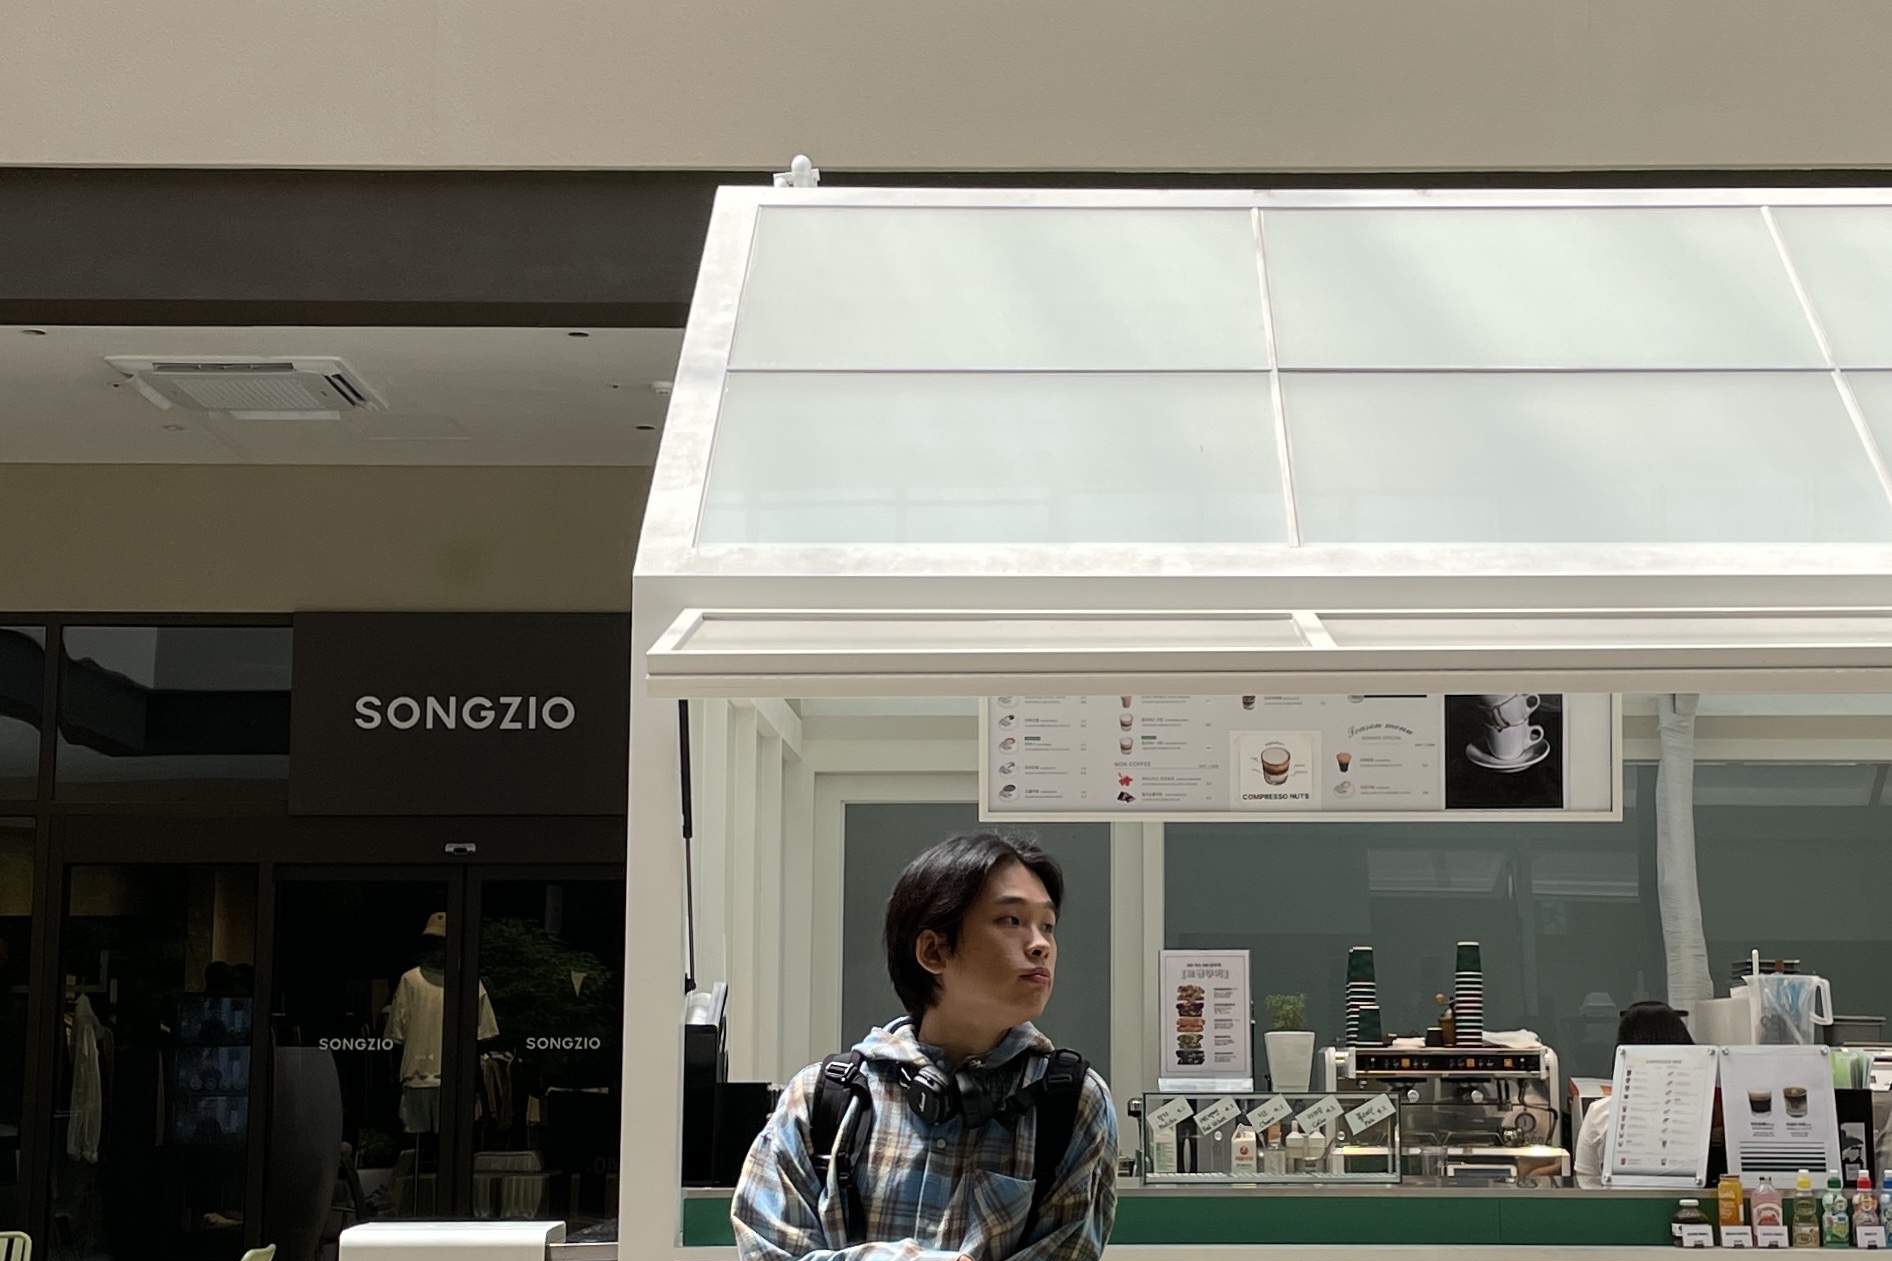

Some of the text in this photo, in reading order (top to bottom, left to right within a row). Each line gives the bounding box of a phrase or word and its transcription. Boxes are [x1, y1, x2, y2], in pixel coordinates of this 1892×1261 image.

[355, 696, 575, 730] SONGZIO
[318, 1037, 394, 1051] SONGZIO
[526, 1036, 601, 1050] SONGZIO
